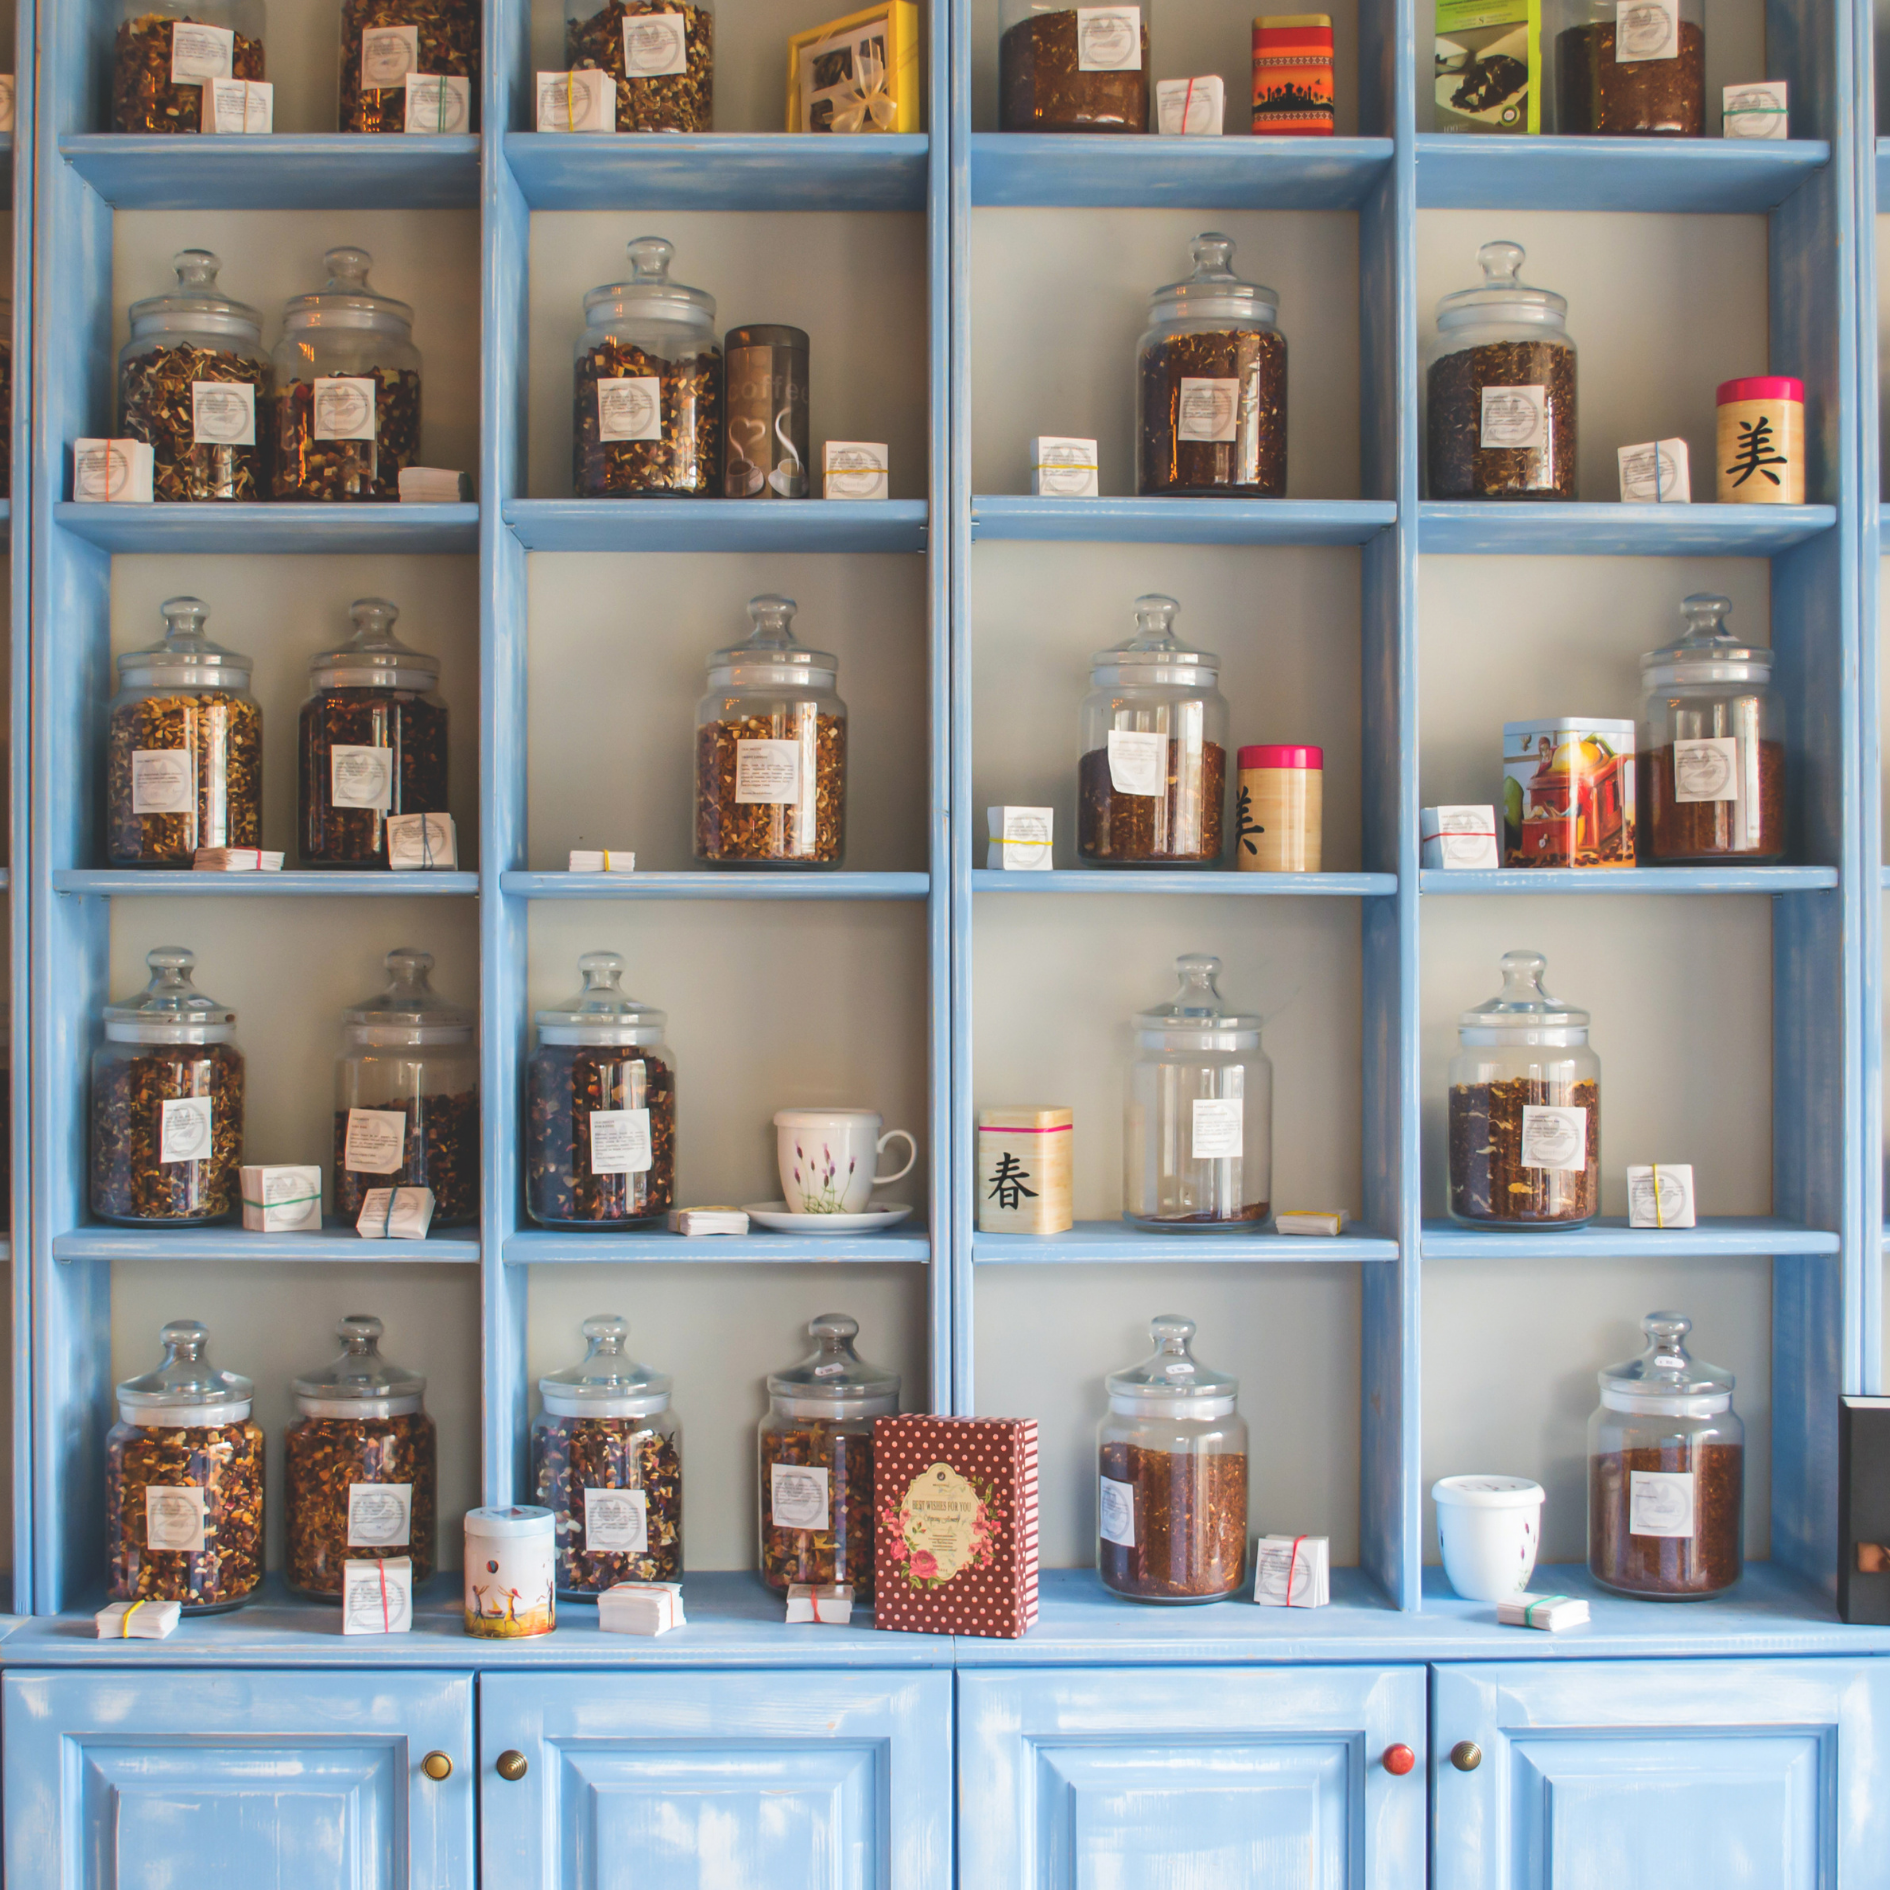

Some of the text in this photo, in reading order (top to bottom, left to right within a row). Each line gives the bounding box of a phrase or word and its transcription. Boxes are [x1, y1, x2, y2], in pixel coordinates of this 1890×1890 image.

[1725, 415, 1788, 488] 美
[987, 1151, 1040, 1210] 春
[912, 1499, 972, 1513] BEST WISHES FOR YOU
